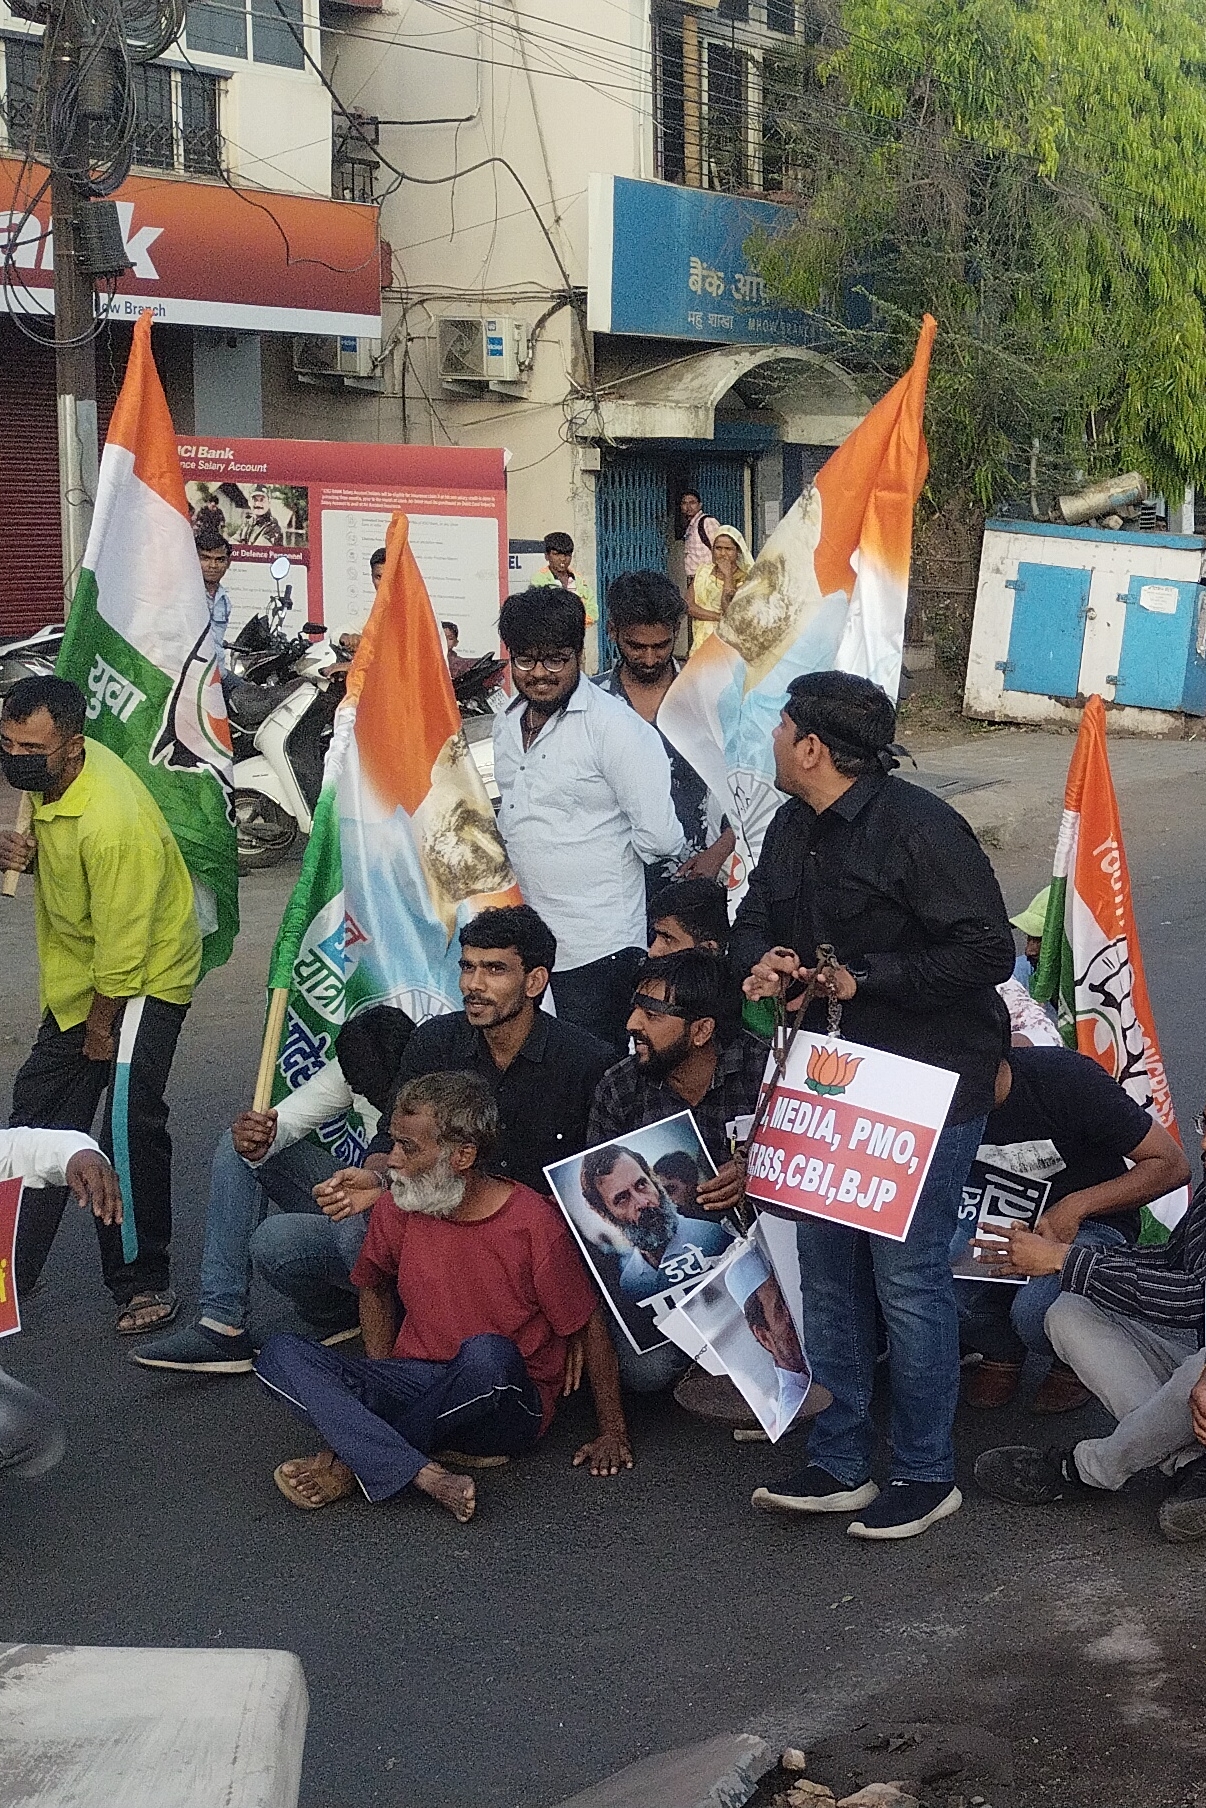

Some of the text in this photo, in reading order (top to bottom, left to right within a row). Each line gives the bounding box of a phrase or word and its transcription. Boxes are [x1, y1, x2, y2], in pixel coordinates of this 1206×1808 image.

[688, 256, 725, 296] बैंक
[198, 446, 234, 459] Bank
[198, 461, 226, 473] Salary
[228, 463, 267, 473] Account
[86, 653, 147, 723] युवा
[769, 1096, 842, 1152] MEDIA,
[847, 1117, 920, 1175] PMO,
